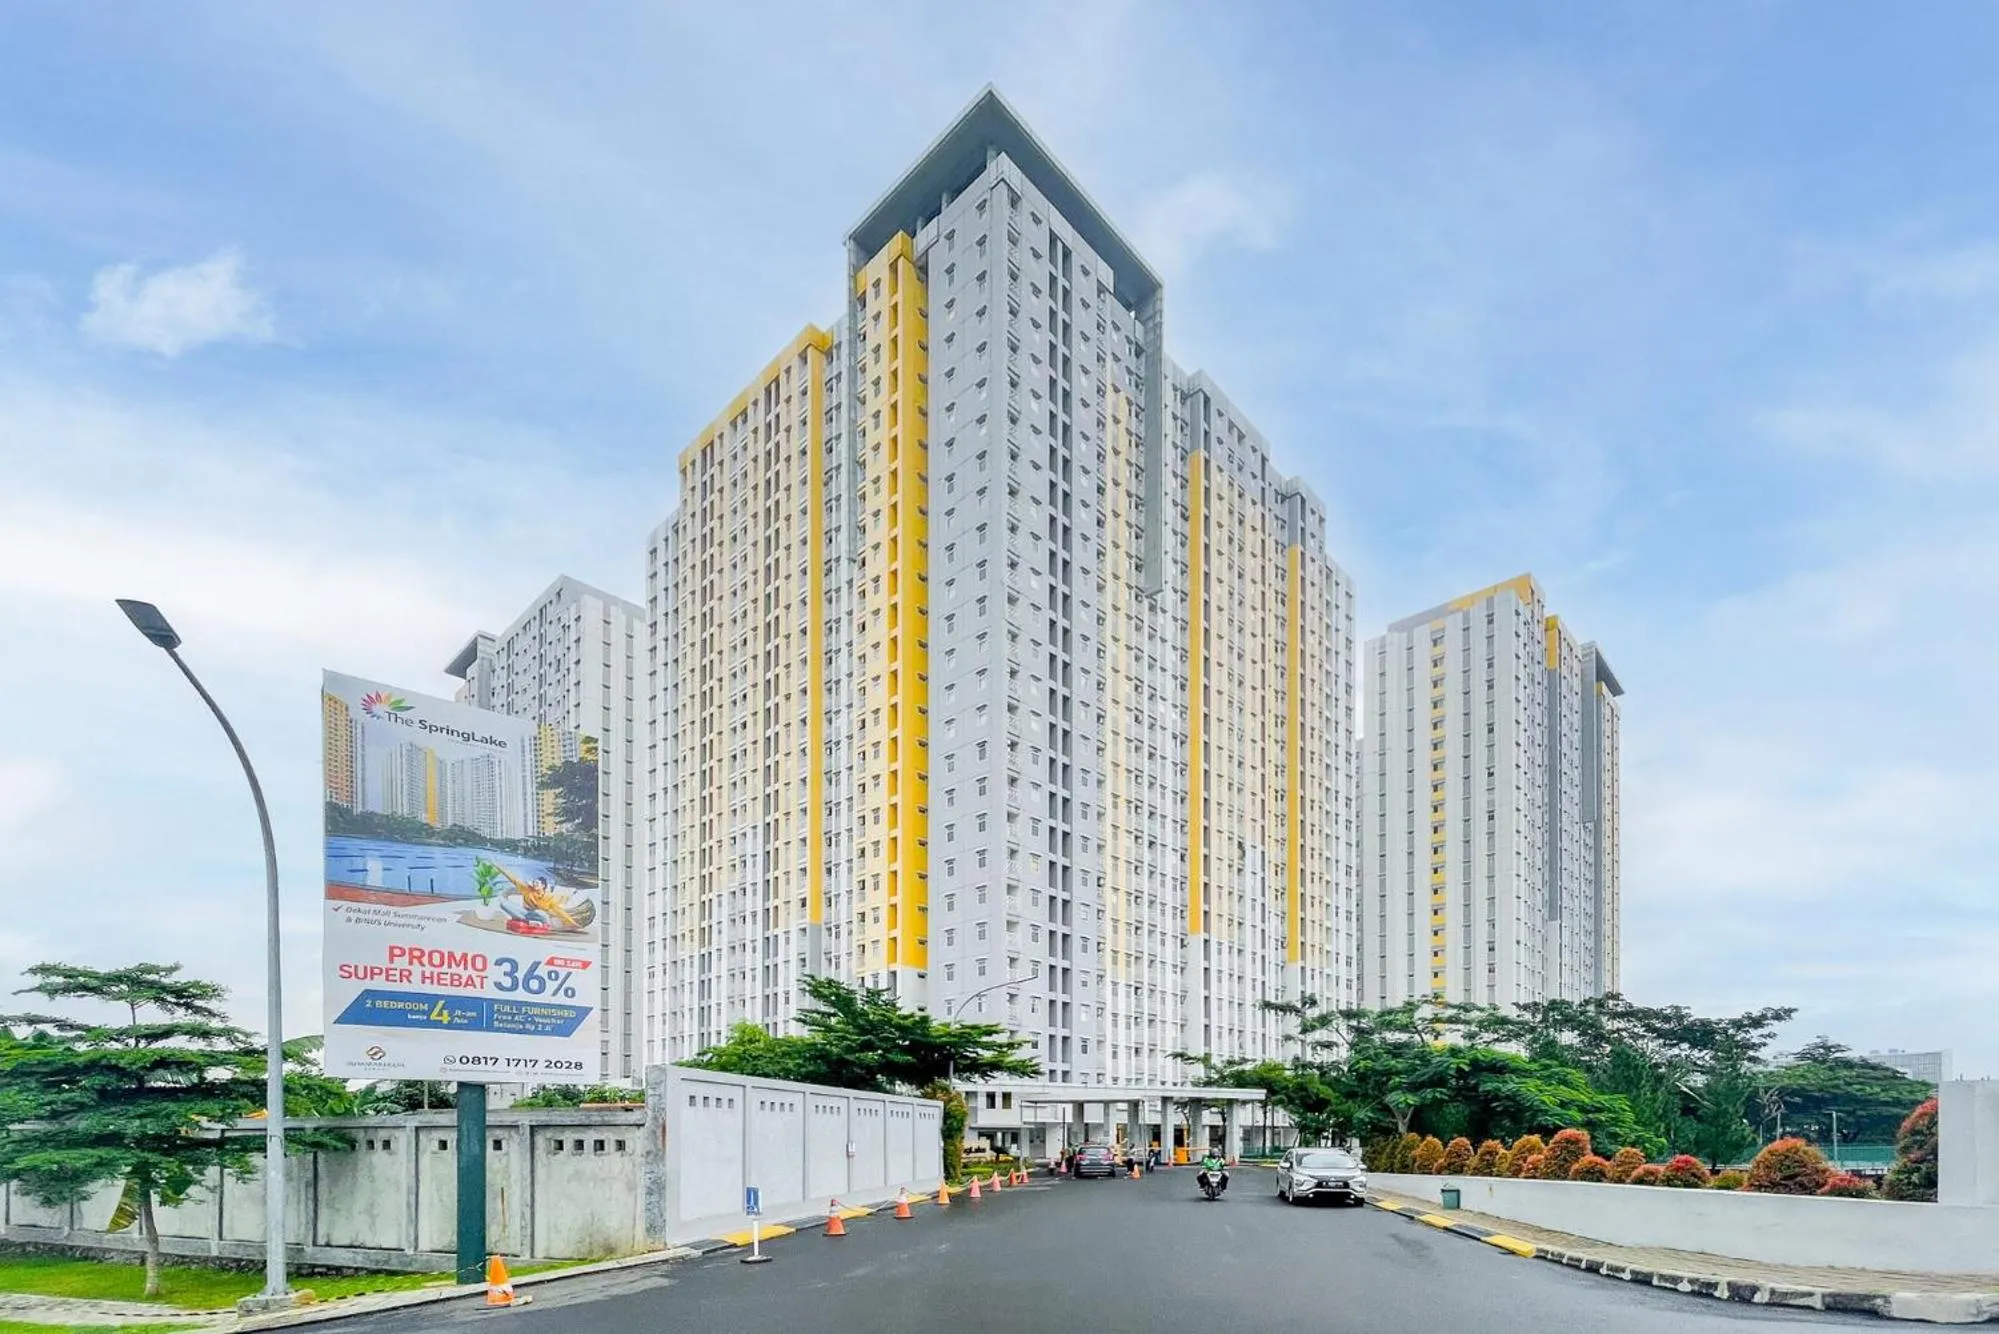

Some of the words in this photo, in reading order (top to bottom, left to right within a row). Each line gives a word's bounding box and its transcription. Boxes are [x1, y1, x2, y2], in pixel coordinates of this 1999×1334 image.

[384, 711, 414, 727] The
[418, 719, 507, 748] SpringLake
[355, 916, 381, 926] BINUS
[383, 919, 426, 931] University
[388, 944, 488, 972] PROMO
[339, 964, 412, 984] SUPER
[420, 970, 488, 990] HEBAT
[493, 957, 577, 999] 36%
[365, 1000, 372, 1008] 2
[375, 1000, 428, 1011] BEDROOM
[430, 1000, 451, 1024] 4
[494, 1004, 518, 1014] FULL
[521, 1006, 576, 1018] FURNISHED
[459, 1055, 499, 1066] 0817
[504, 1057, 538, 1068] 1717
[544, 1059, 584, 1070] 2028
